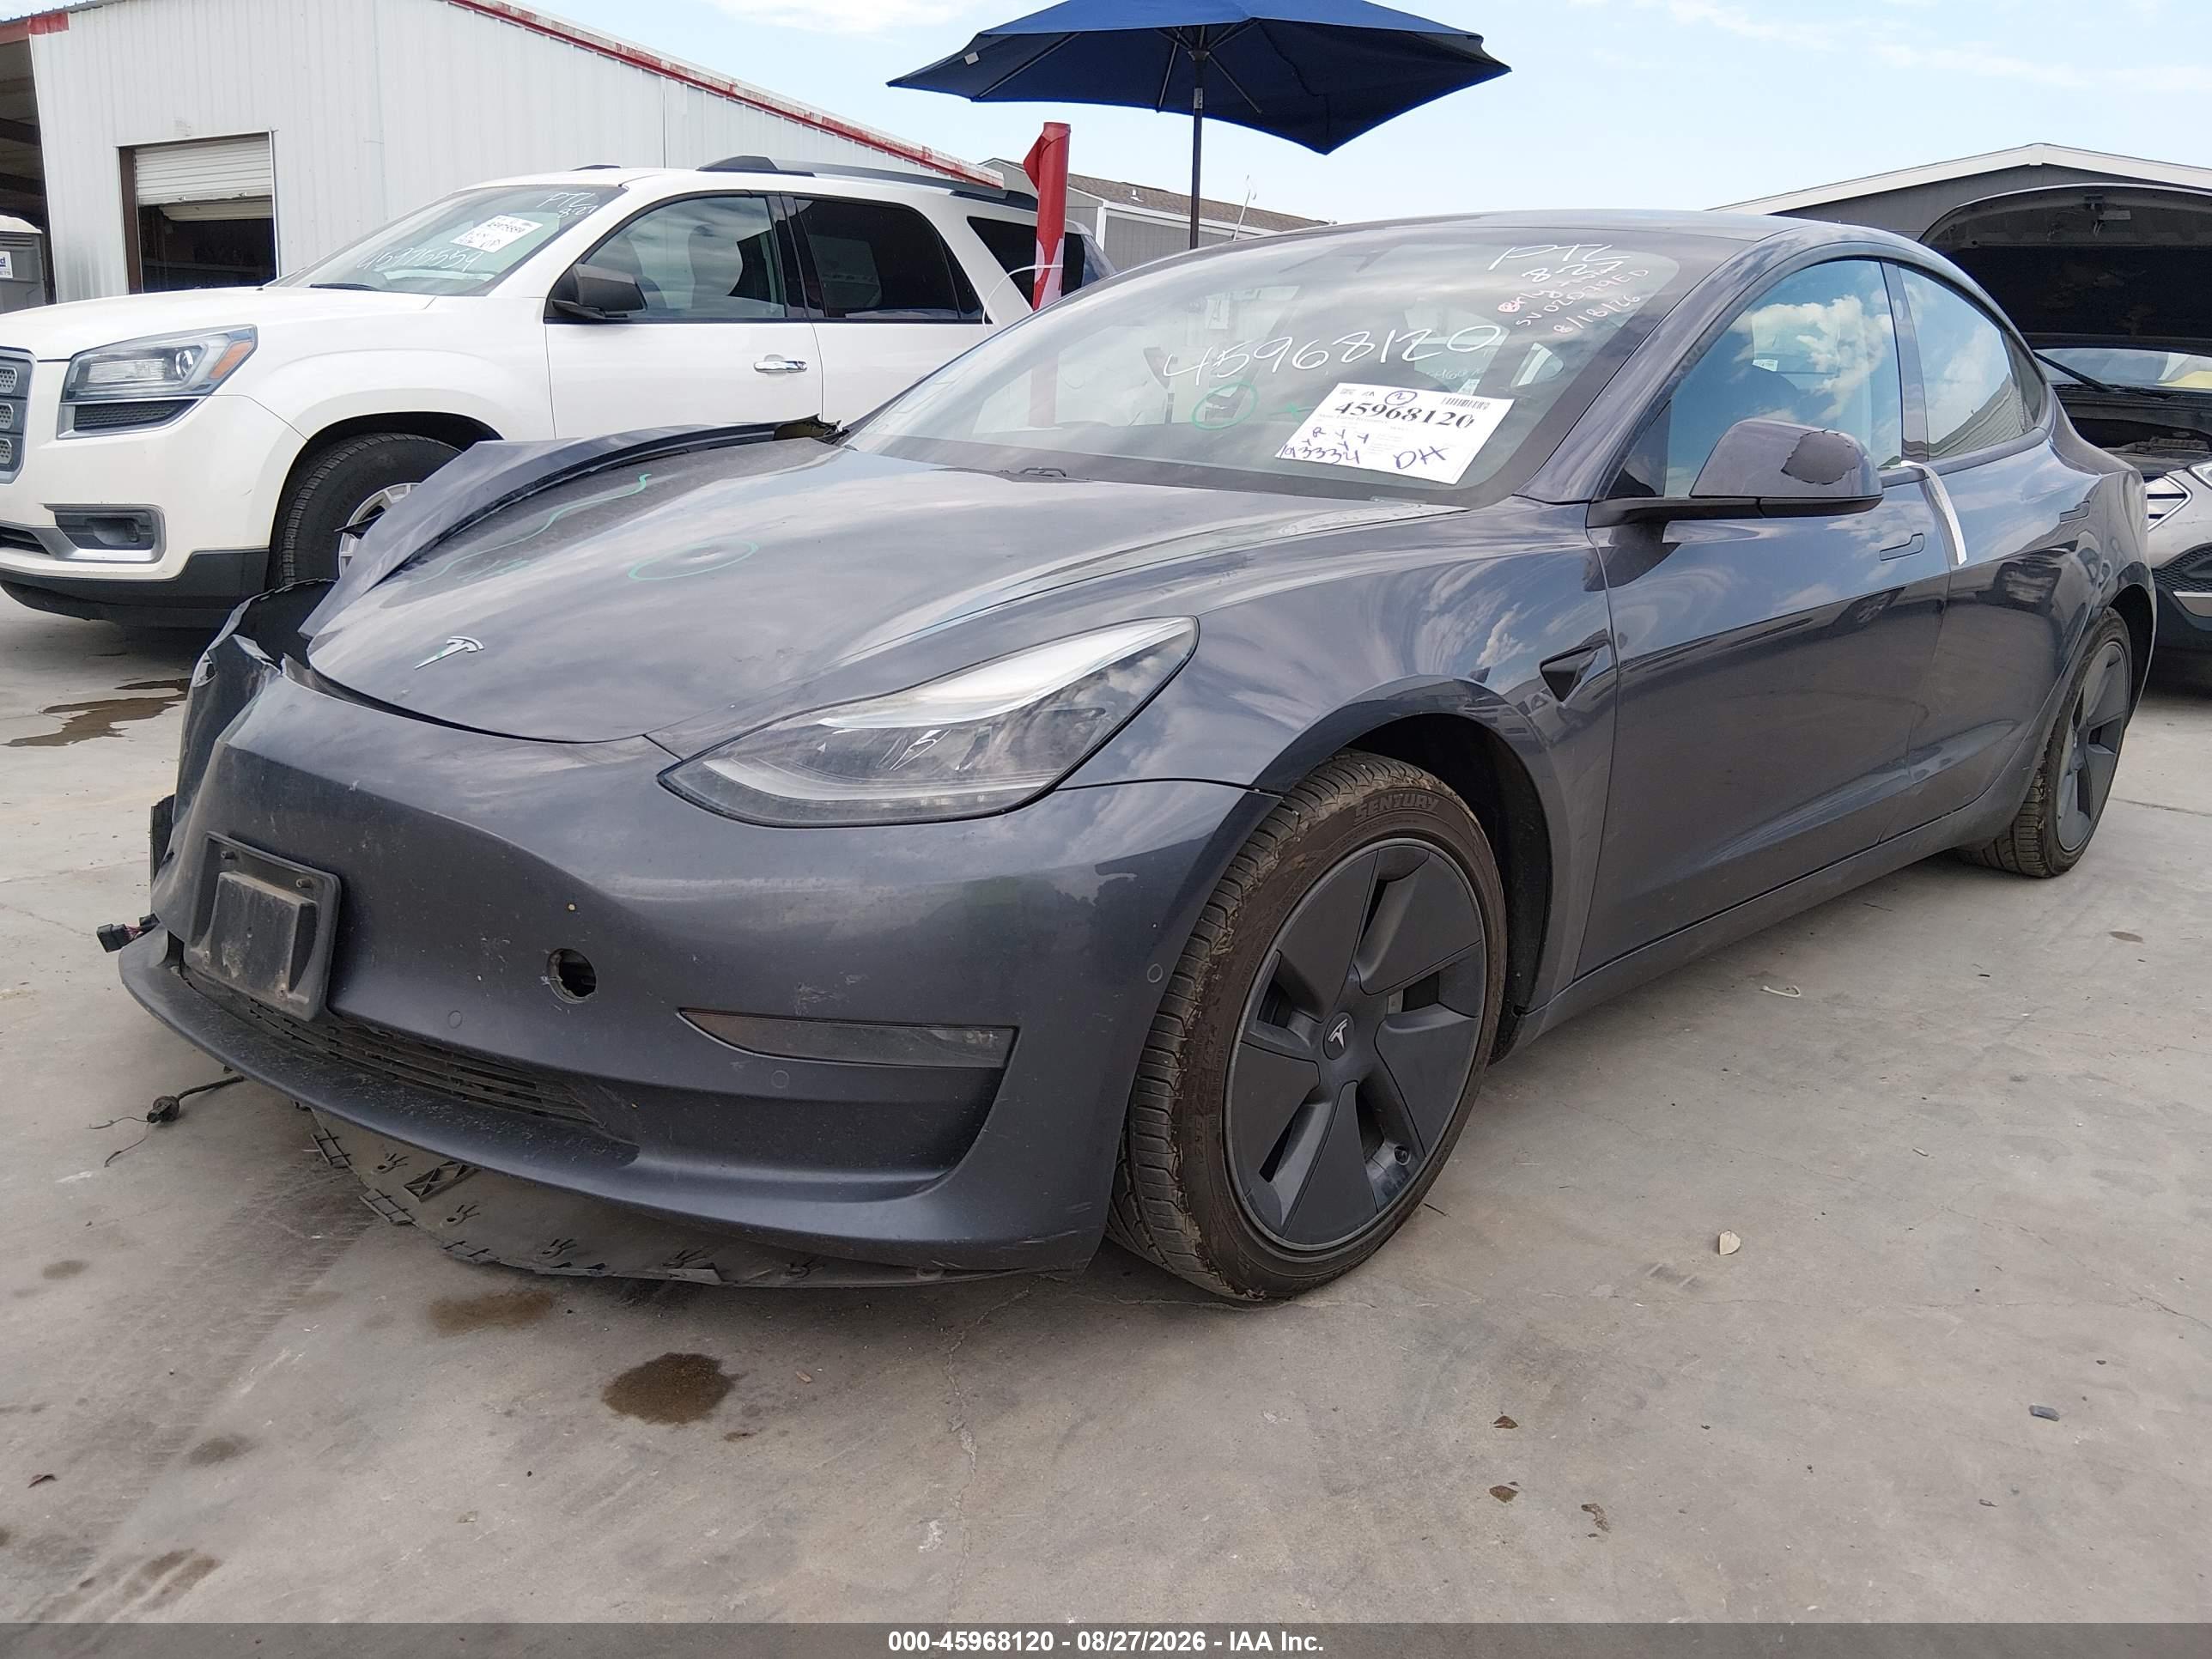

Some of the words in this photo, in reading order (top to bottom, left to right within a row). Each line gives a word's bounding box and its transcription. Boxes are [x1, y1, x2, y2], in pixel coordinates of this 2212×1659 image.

[1163, 325, 1502, 386] 45968120
[1334, 401, 1475, 429] 45968120
[1354, 793, 1439, 822] SENTURY
